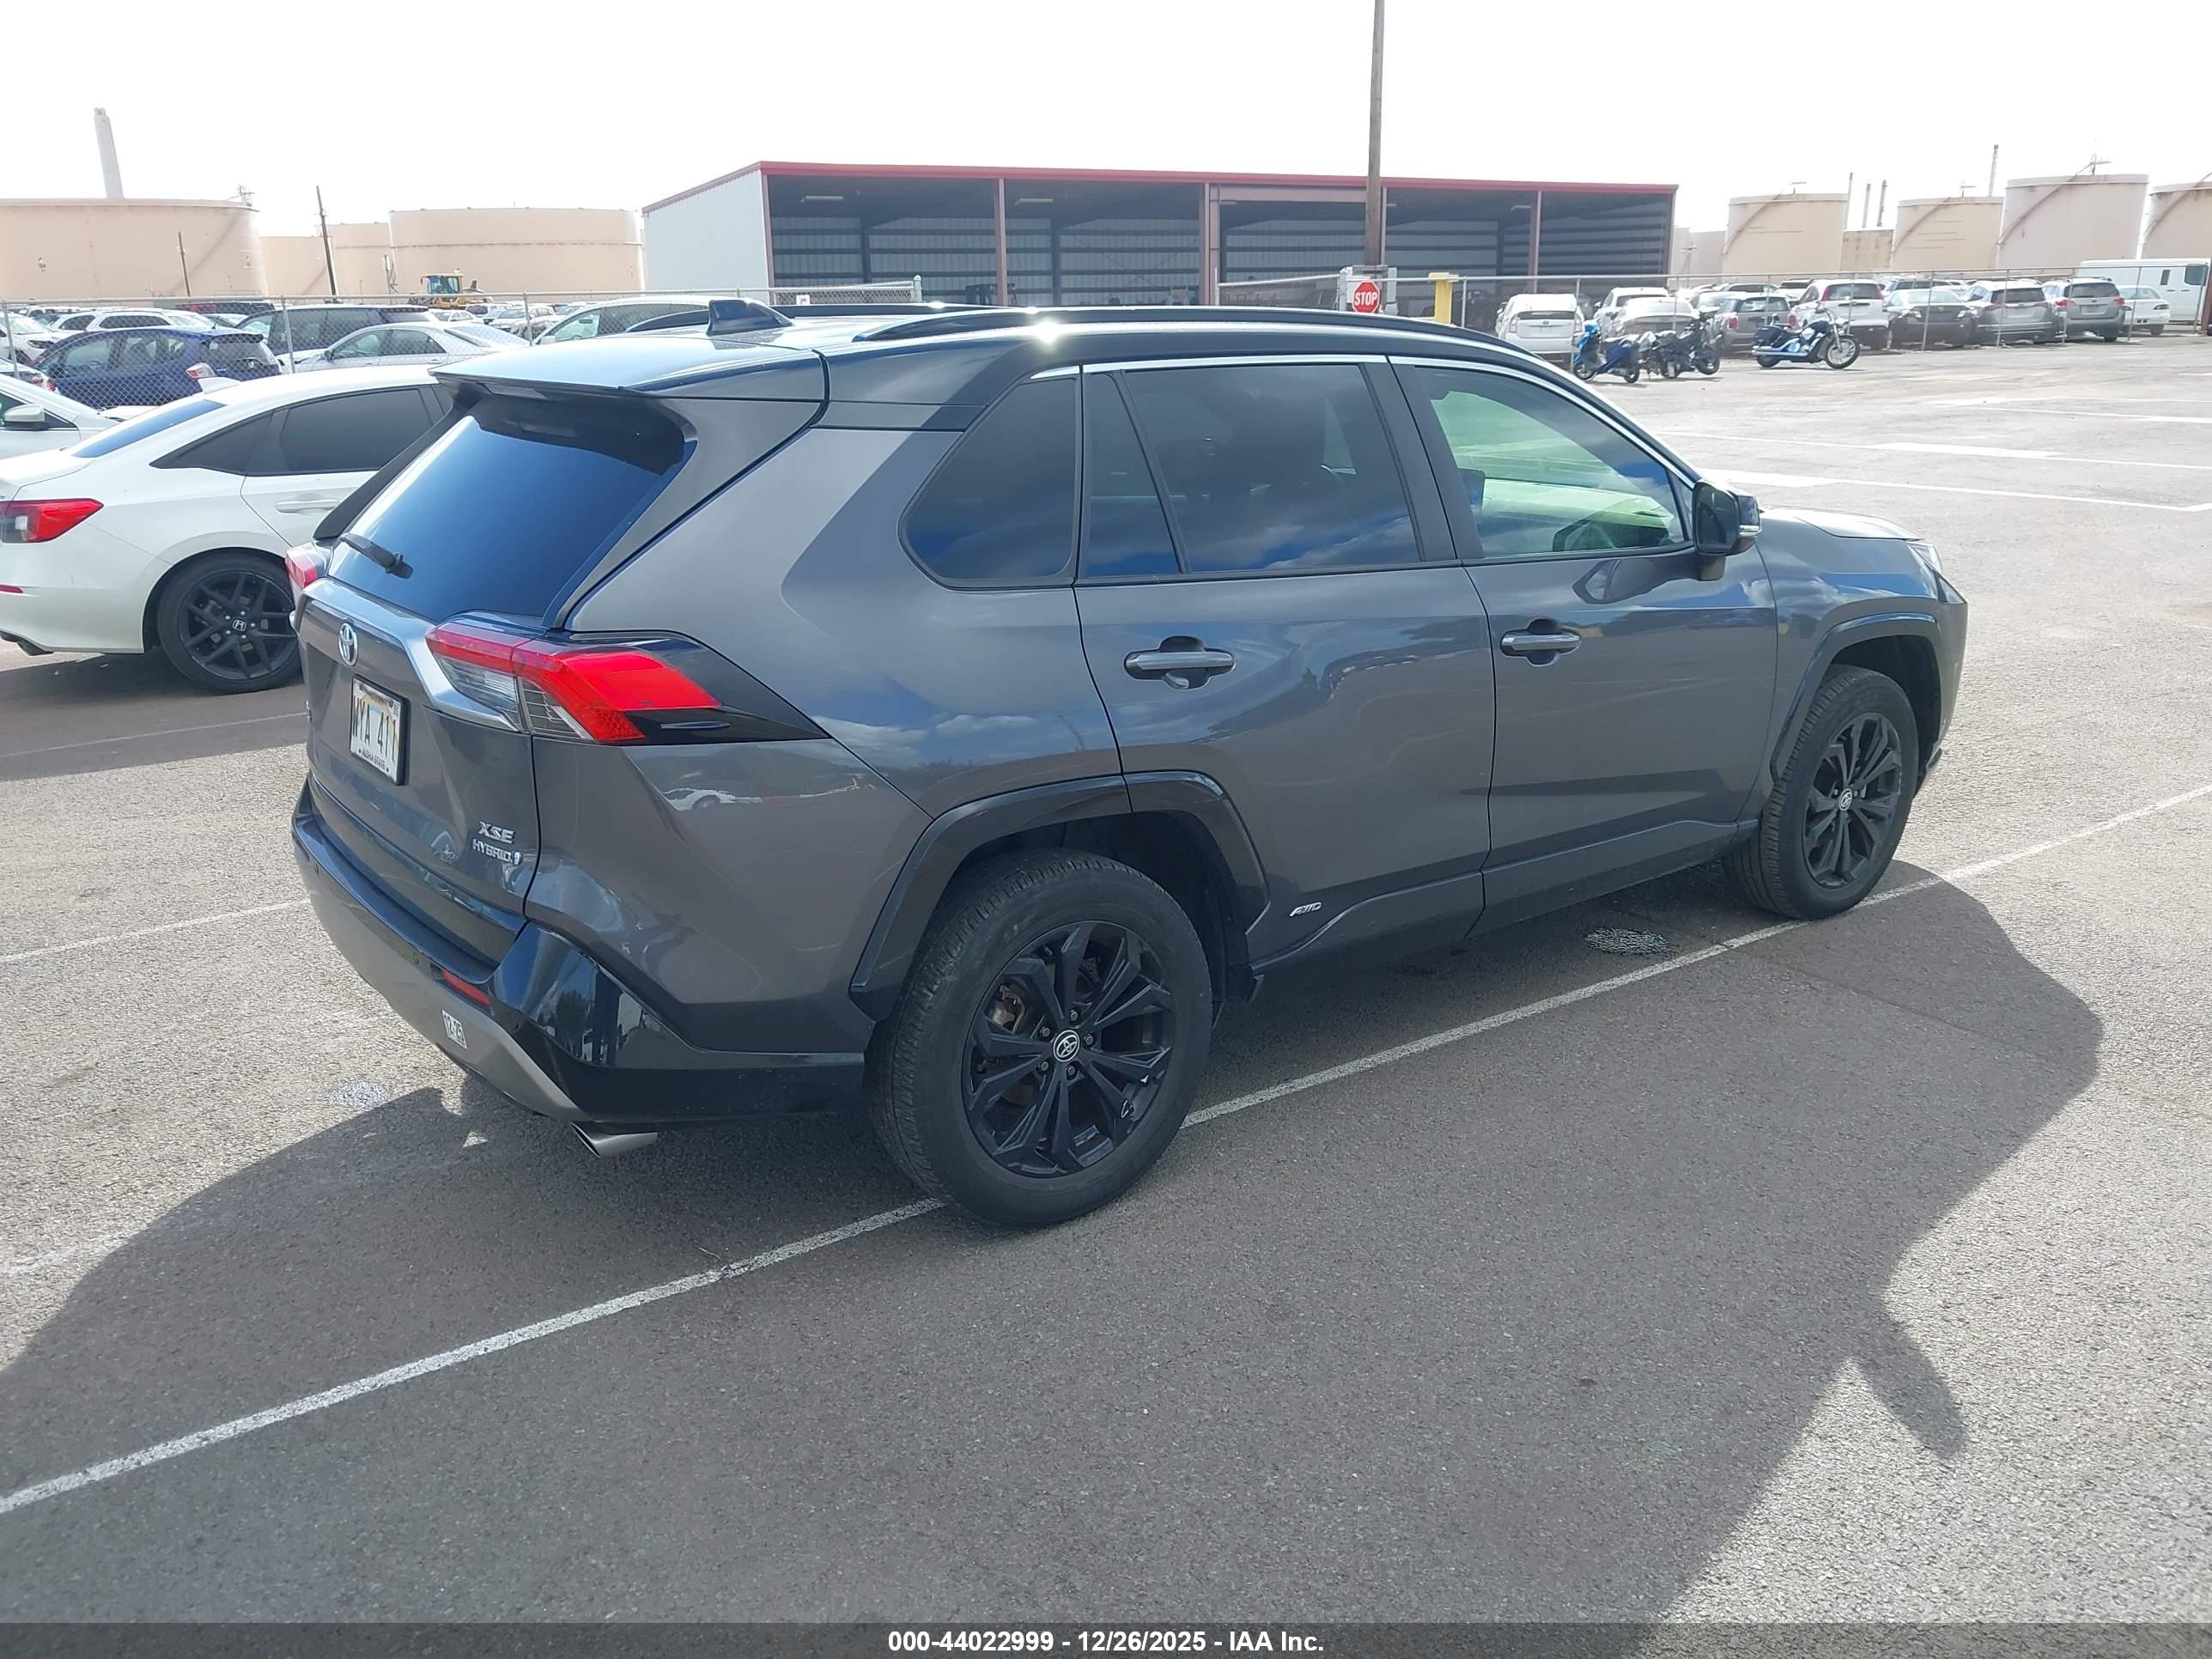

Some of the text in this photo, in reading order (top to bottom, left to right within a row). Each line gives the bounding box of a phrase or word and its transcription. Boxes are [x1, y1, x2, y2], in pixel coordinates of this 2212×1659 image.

[1354, 292, 1377, 306] STOP
[477, 820, 514, 844] XSE
[472, 838, 513, 864] HYBRID
